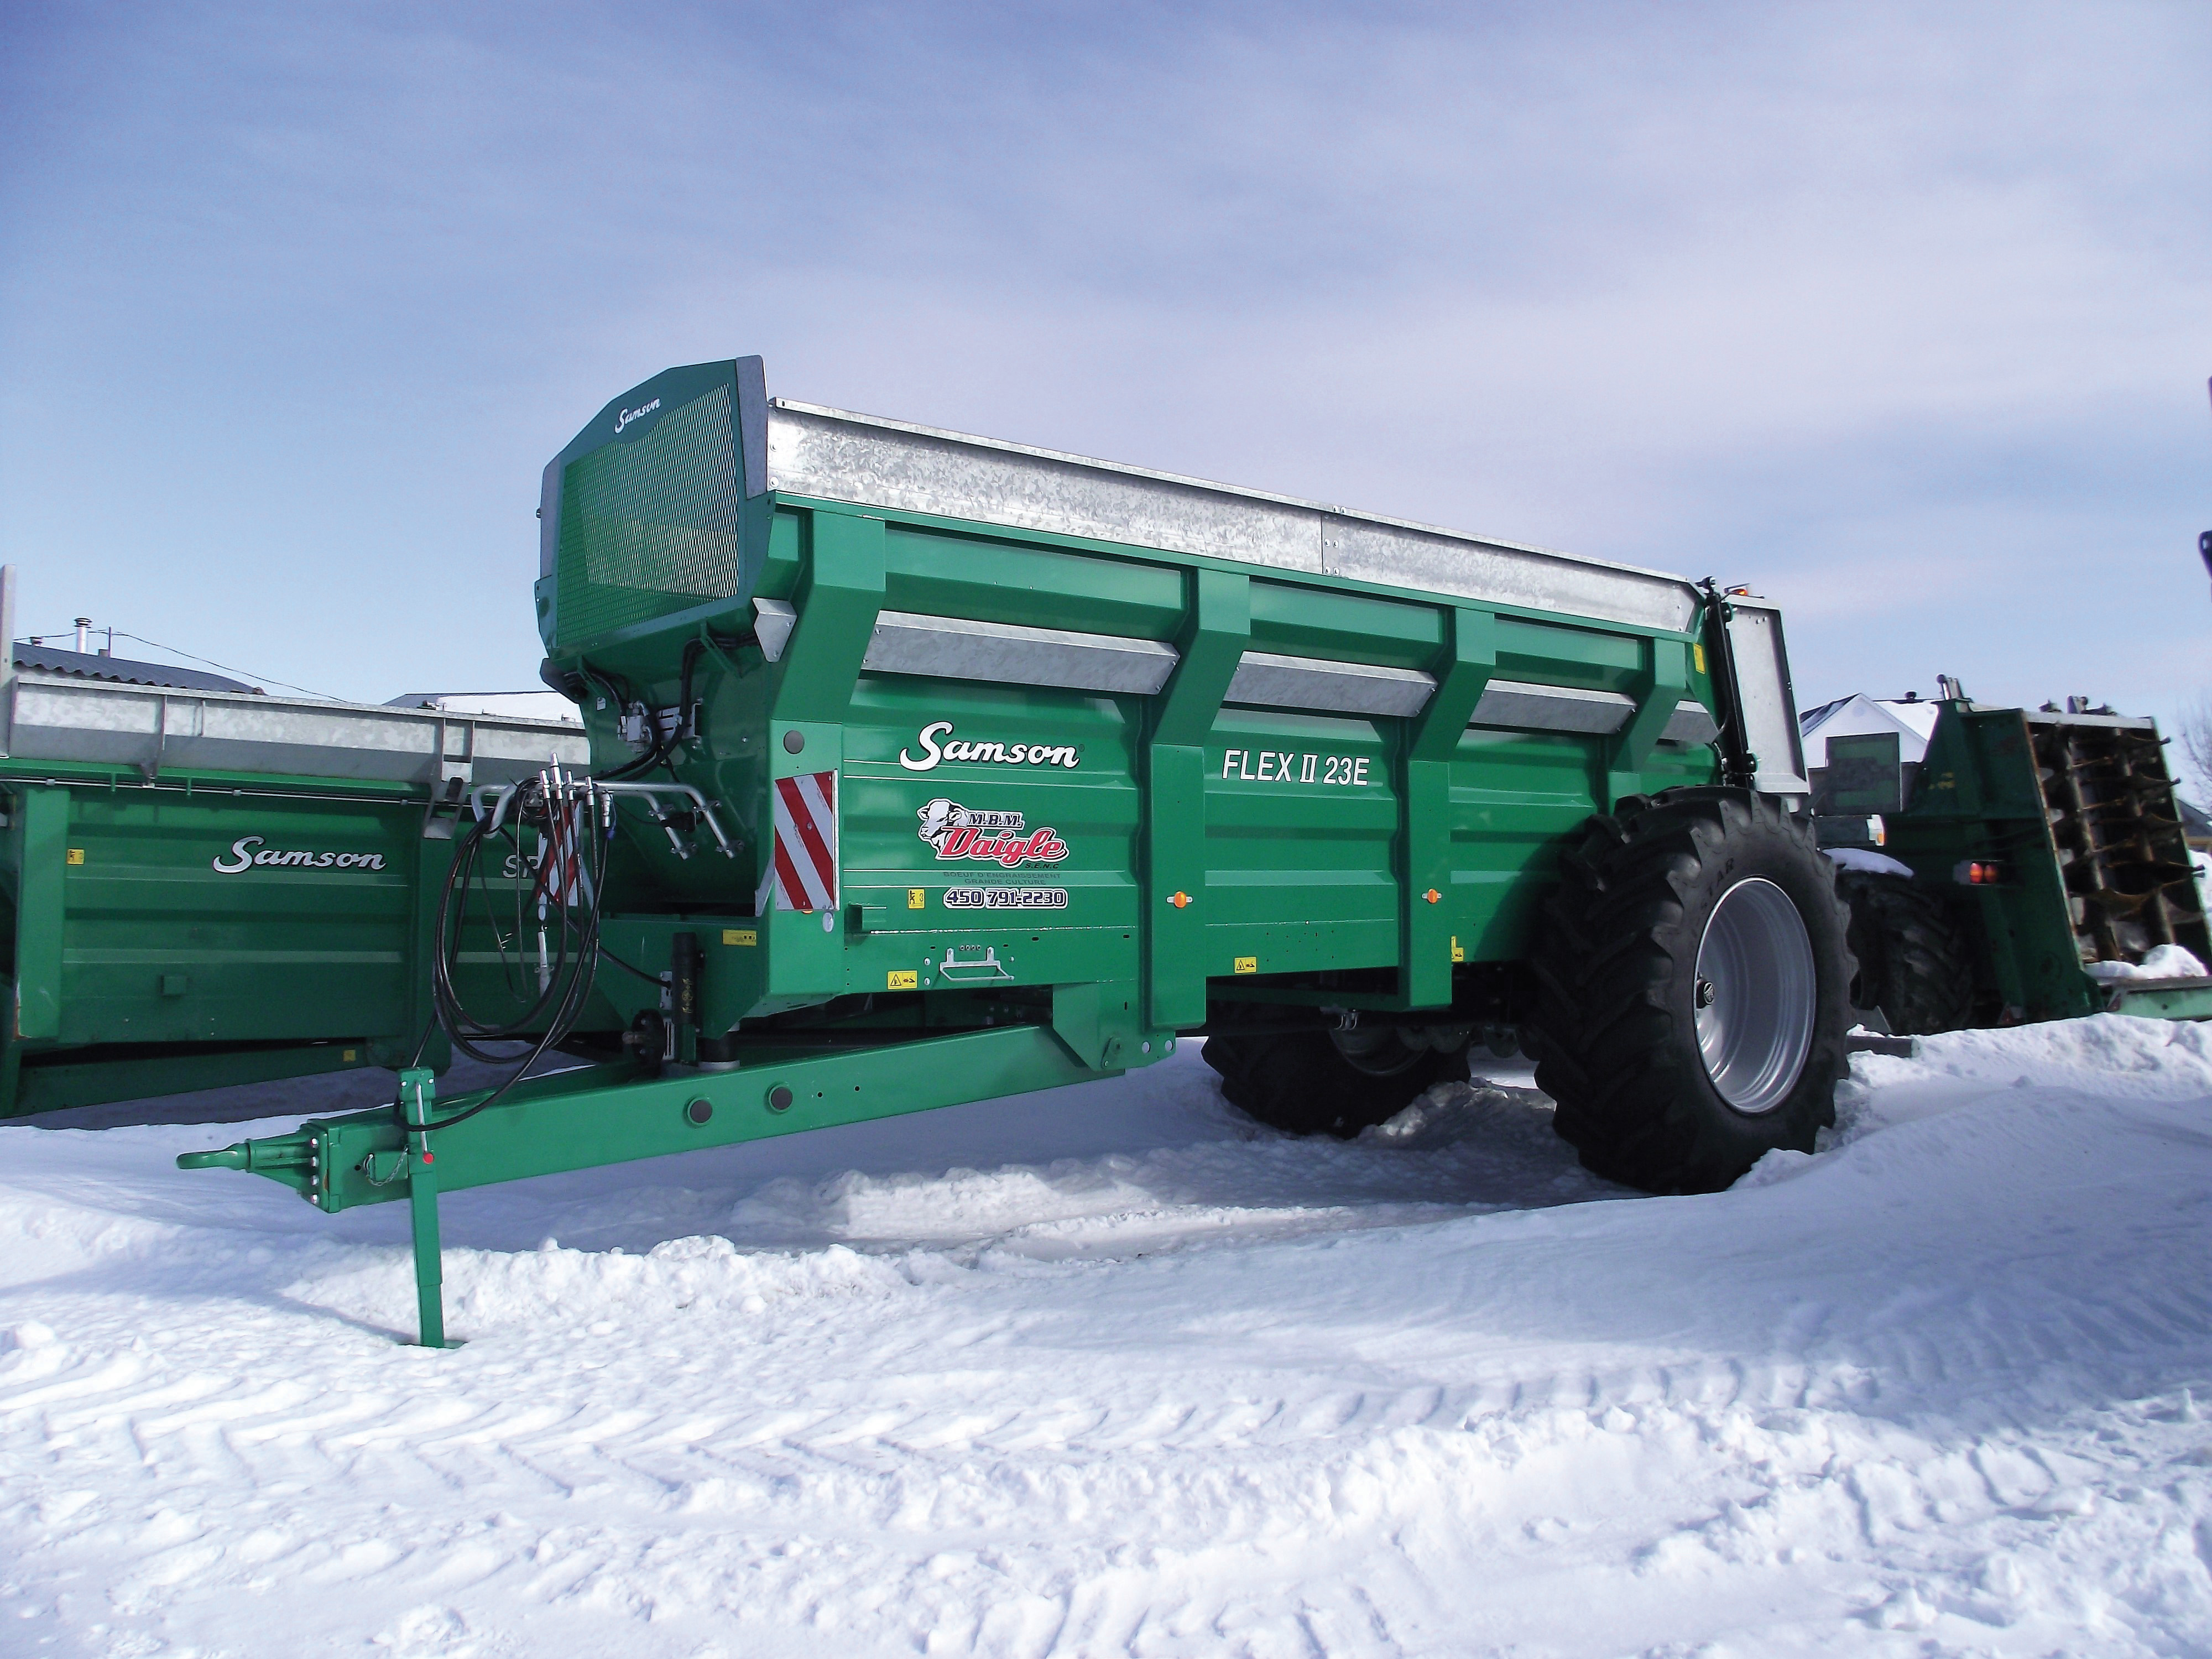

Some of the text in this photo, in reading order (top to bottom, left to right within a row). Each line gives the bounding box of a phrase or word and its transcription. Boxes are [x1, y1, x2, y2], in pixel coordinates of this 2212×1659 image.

[614, 398, 661, 434] Samson
[899, 721, 1080, 771] Samson
[1222, 749, 1295, 782] FLEX
[1323, 755, 1370, 786] 23E
[969, 811, 1023, 827] M.B.M.
[212, 835, 387, 874] Samson
[938, 826, 1067, 865] Daigle
[945, 888, 1068, 908] 450 791-2230
